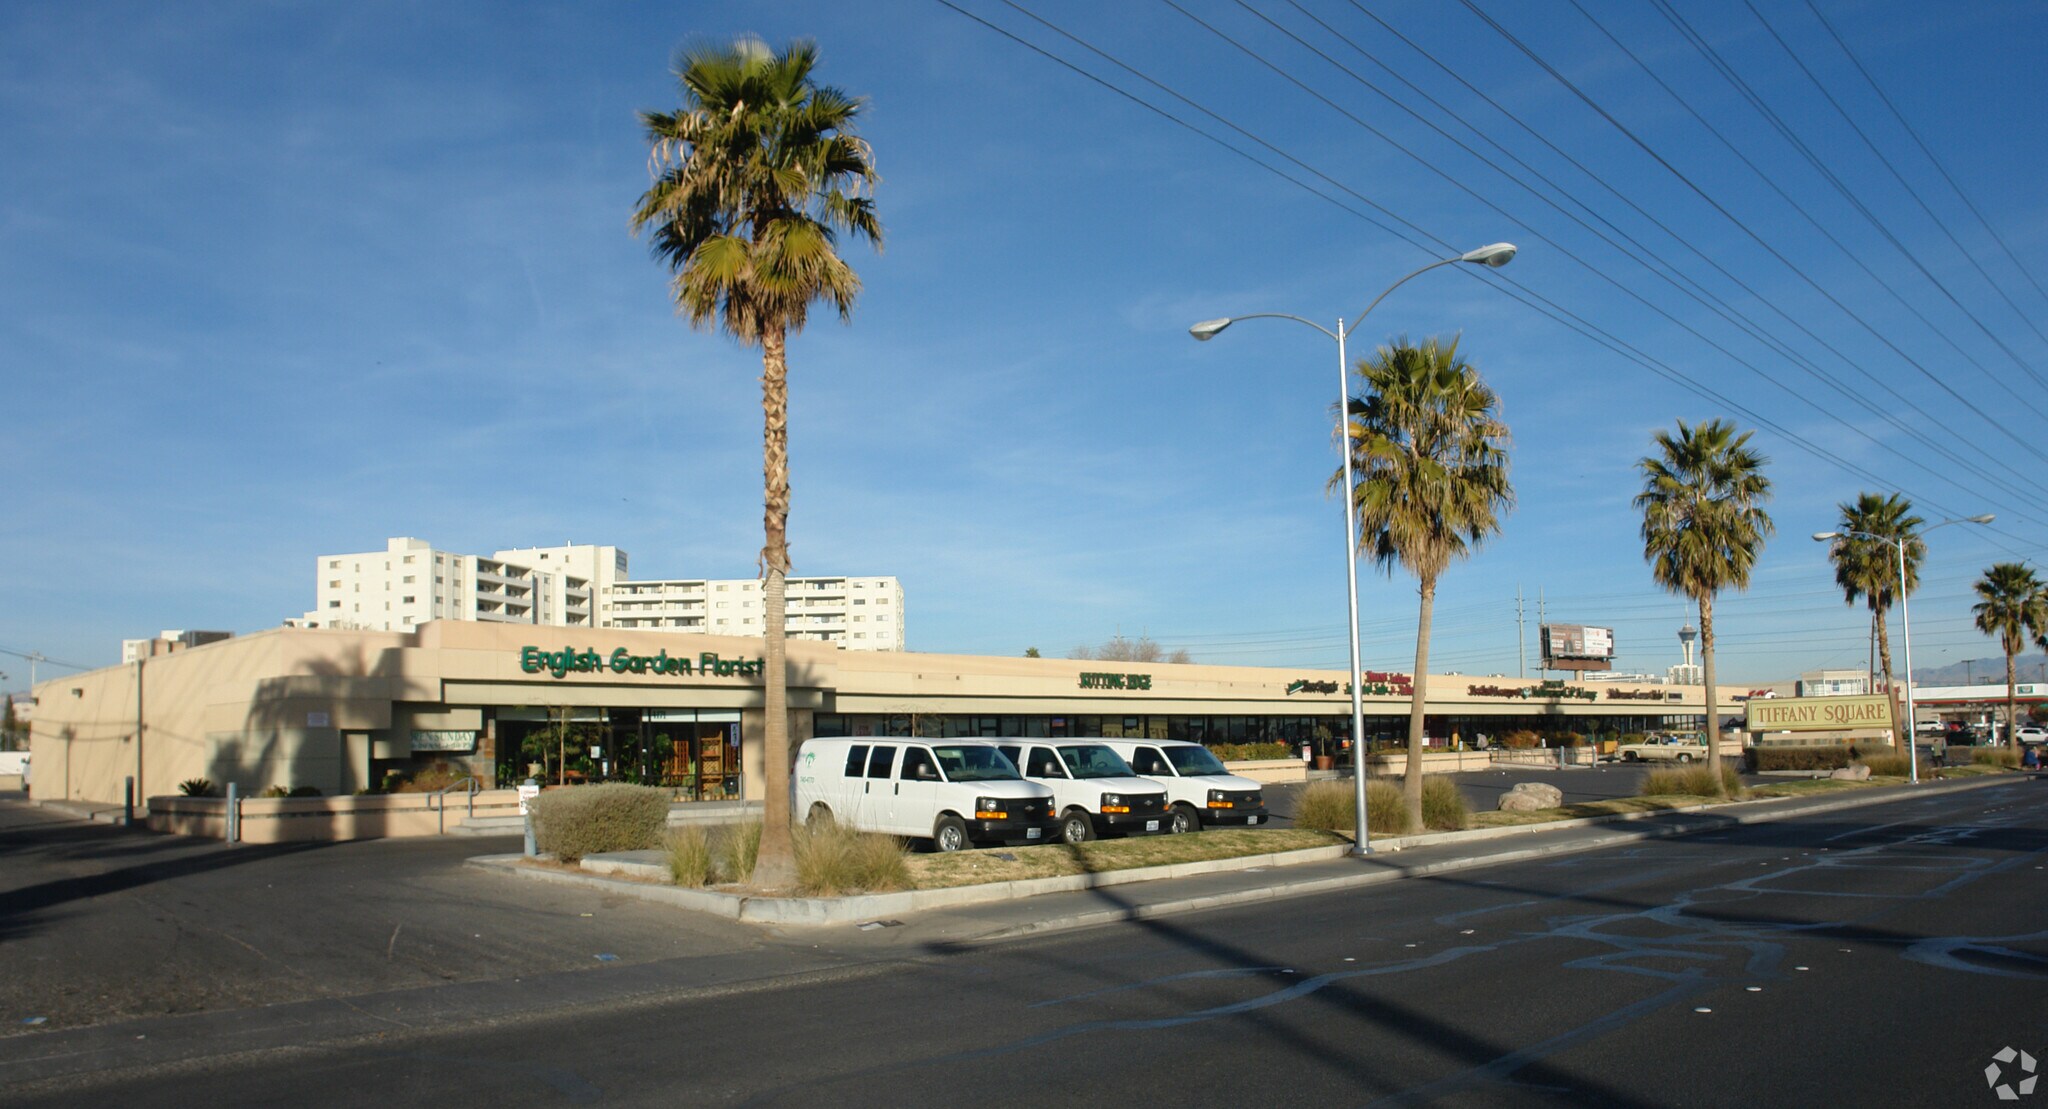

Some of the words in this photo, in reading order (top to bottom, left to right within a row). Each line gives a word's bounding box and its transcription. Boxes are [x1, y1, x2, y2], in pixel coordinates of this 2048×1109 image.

[521, 646, 602, 678] English
[609, 647, 692, 676] Garden
[699, 652, 765, 676] Florist
[1757, 706, 1817, 722] TIFFANY
[1824, 703, 1886, 724] SQUARE
